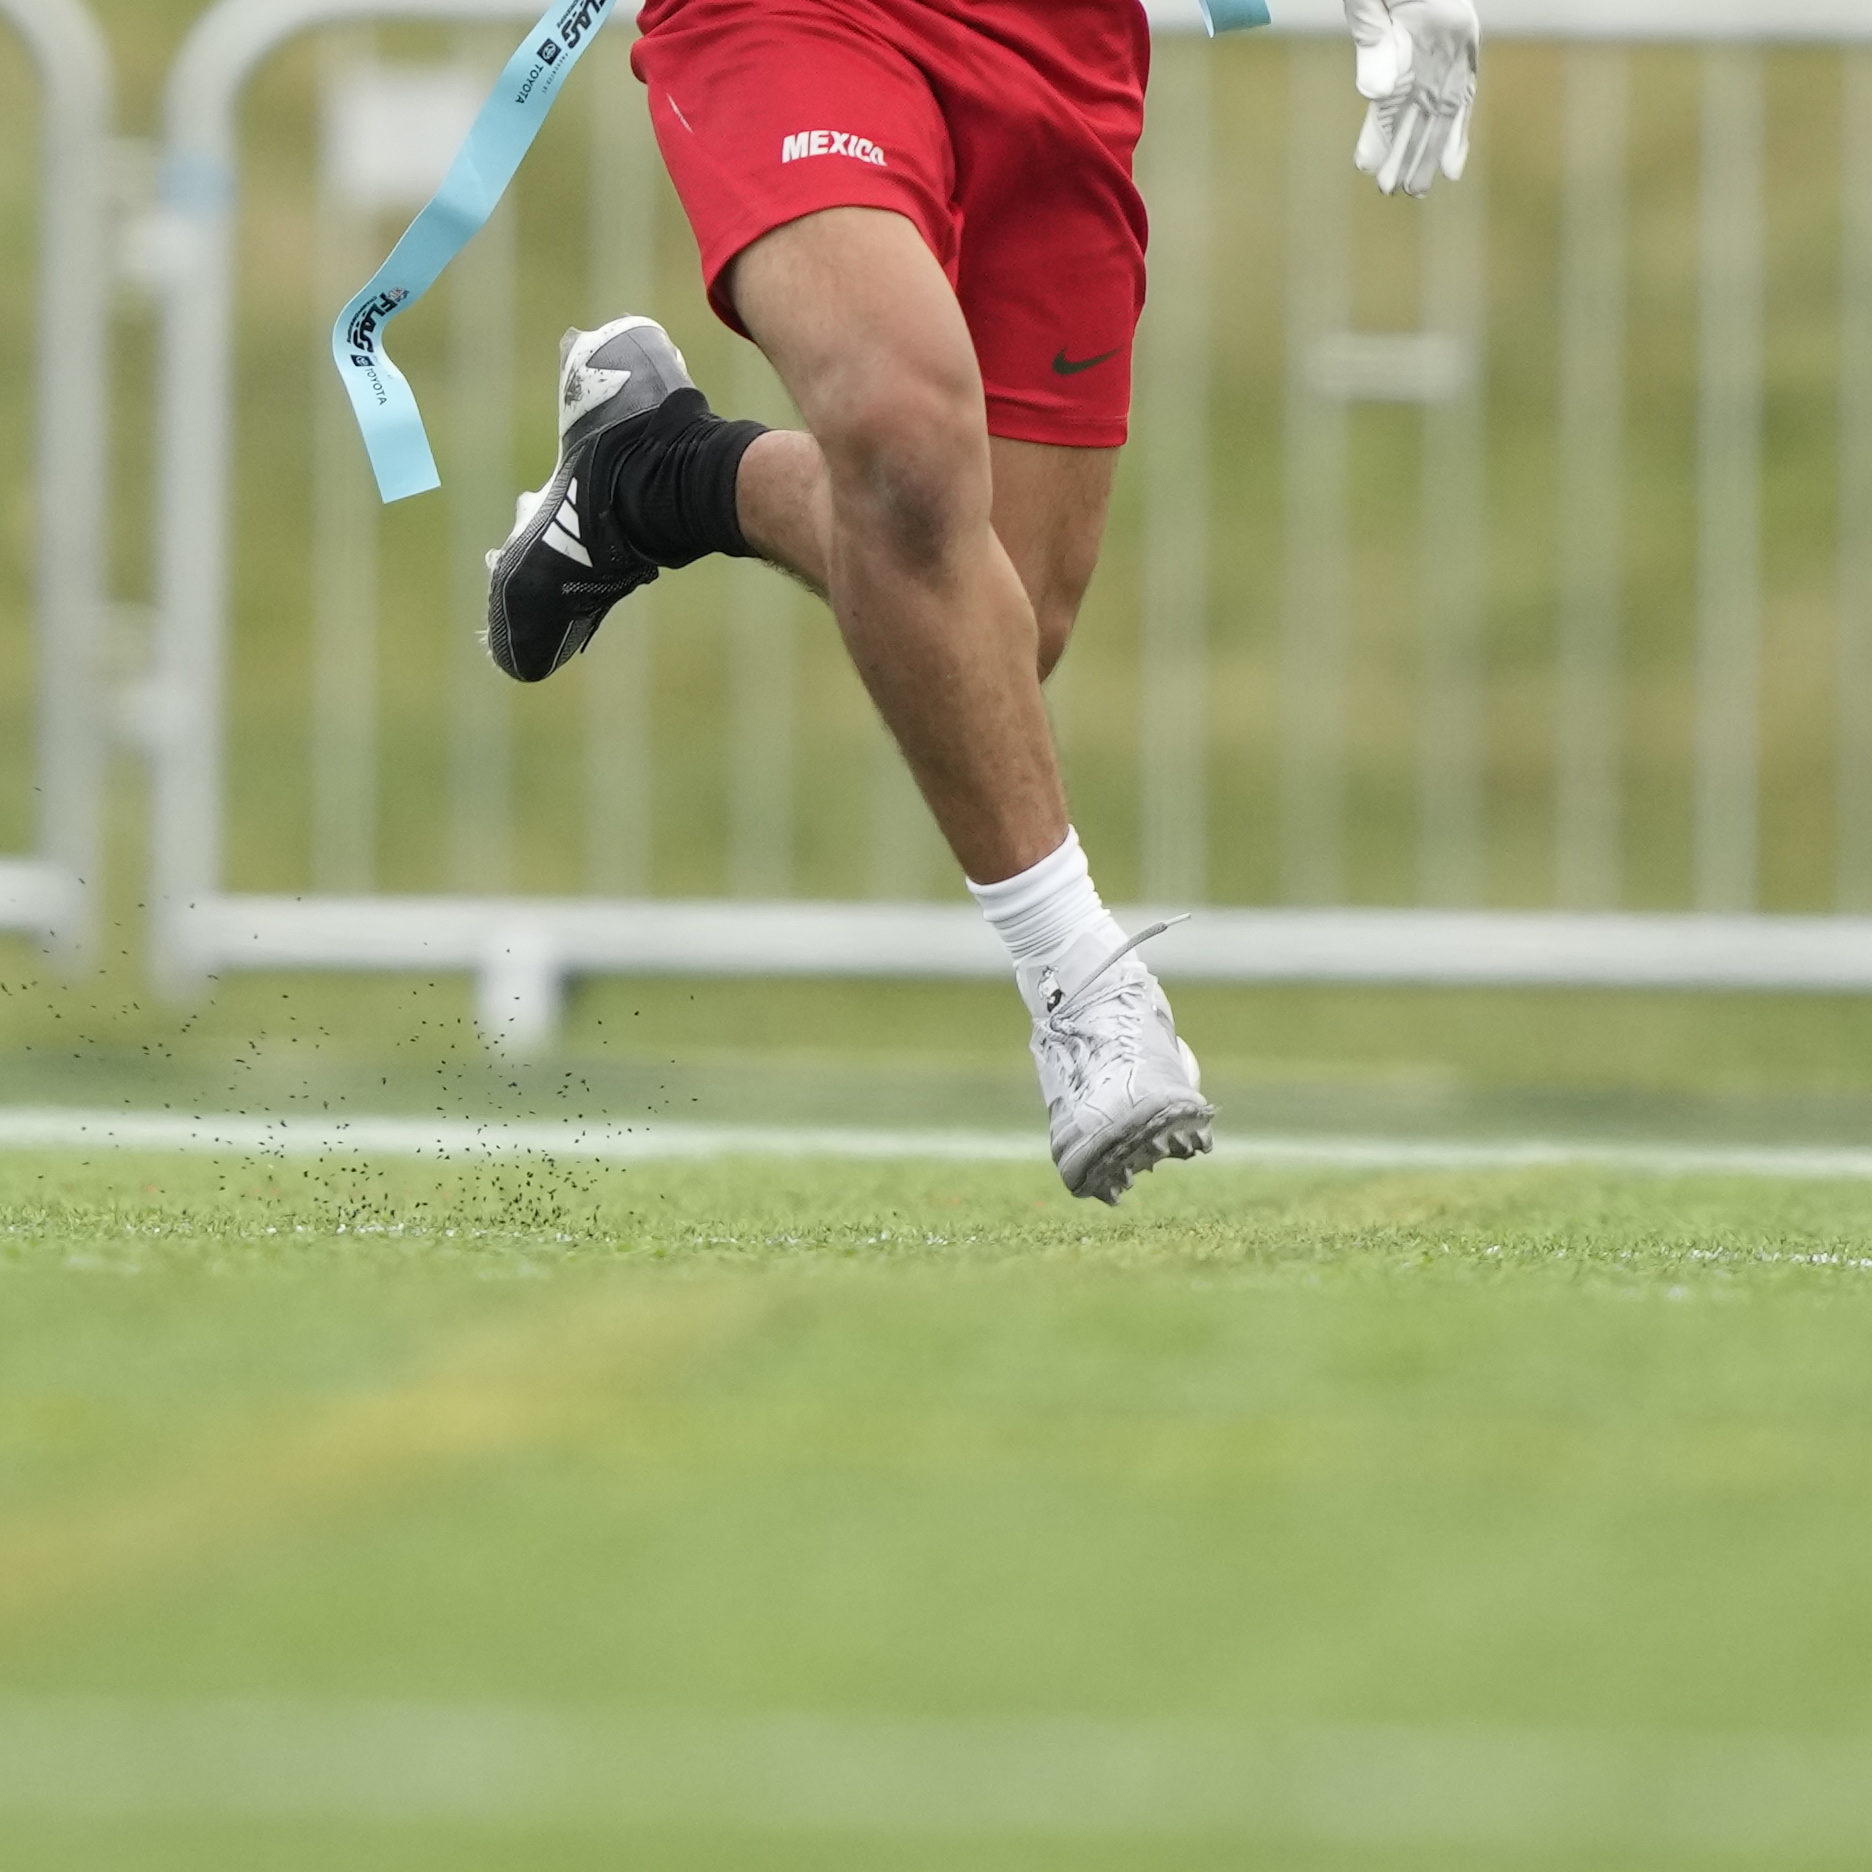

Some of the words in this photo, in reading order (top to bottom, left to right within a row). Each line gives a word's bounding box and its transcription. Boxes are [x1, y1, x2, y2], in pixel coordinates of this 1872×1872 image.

[515, 63, 544, 104] TOYOTA
[781, 129, 888, 167] MEXICO
[353, 292, 398, 353] FLAG
[365, 367, 388, 406] TOYOTA
